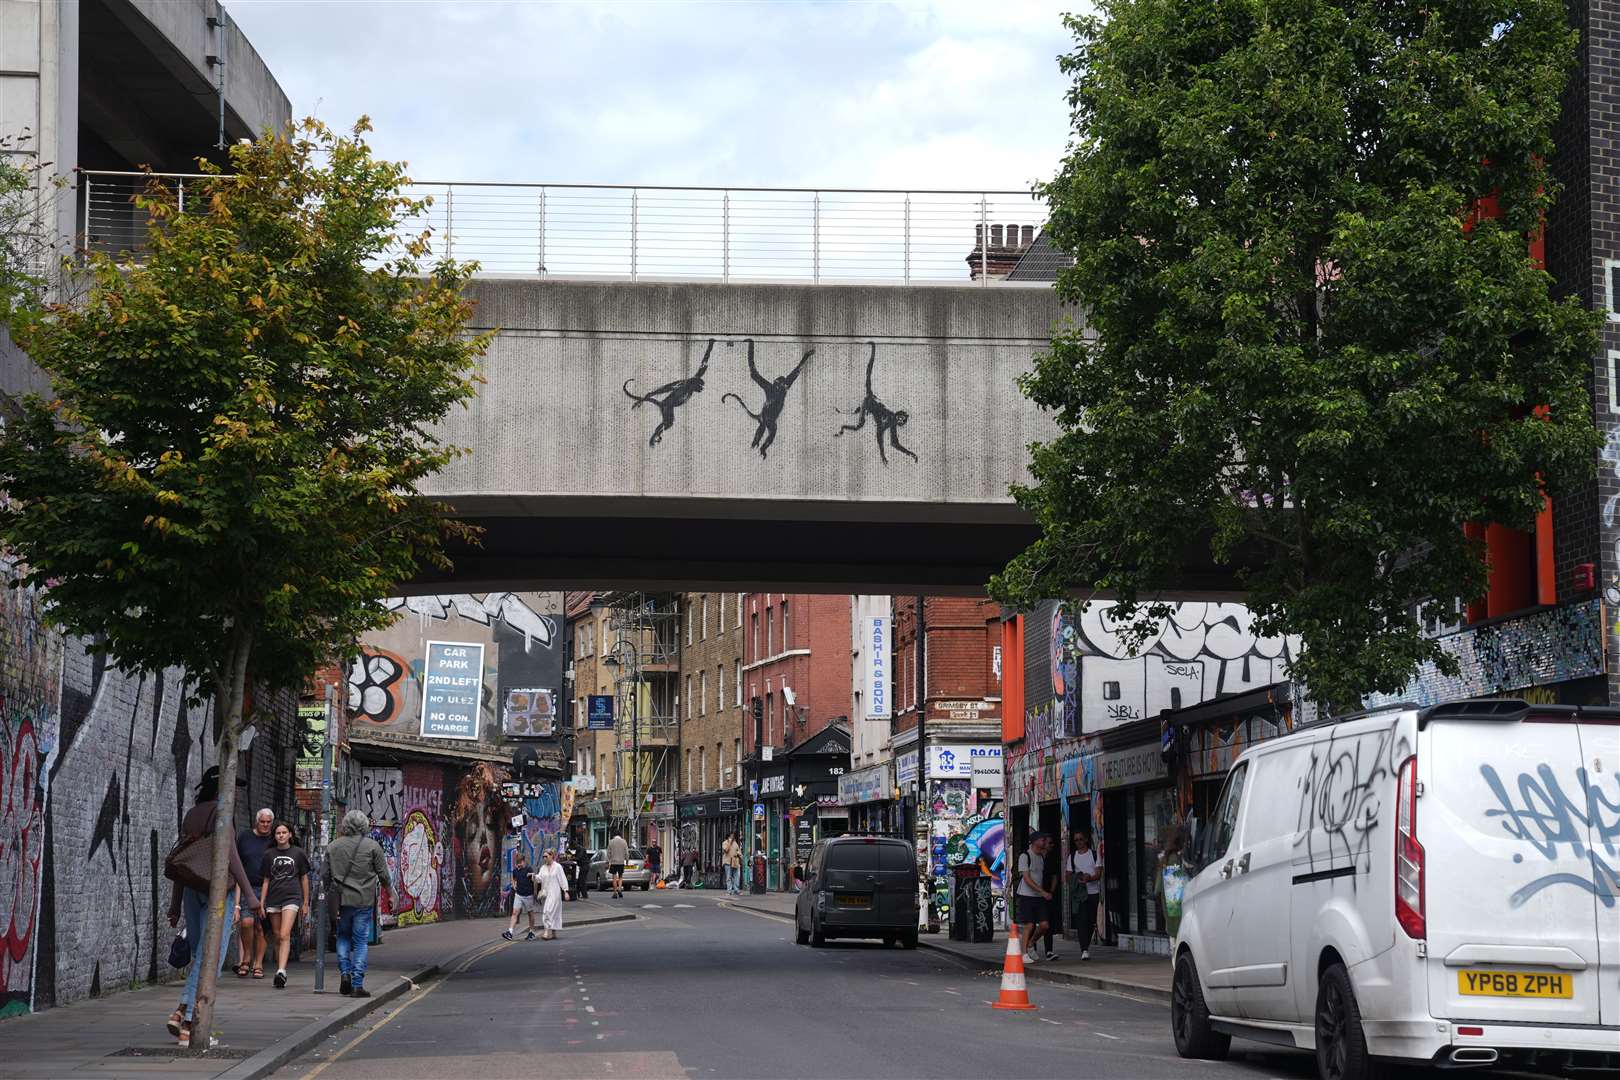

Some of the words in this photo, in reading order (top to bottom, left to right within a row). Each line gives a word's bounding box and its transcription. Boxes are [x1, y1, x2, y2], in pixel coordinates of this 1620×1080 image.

[873, 619, 883, 667] BASHIR
[443, 647, 467, 657] CAR
[439, 659, 468, 669] PARK
[873, 670, 883, 678] &
[428, 675, 451, 685] 2ND
[452, 677, 479, 687] LEFT
[430, 695, 443, 703] NO
[447, 695, 475, 705] ULEZ
[873, 681, 884, 713] SONS
[430, 712, 446, 721] NO
[430, 723, 469, 733] CHARGE
[828, 767, 844, 775] 182
[1466, 973, 1518, 992] YP68
[1523, 975, 1563, 994] ZPH
